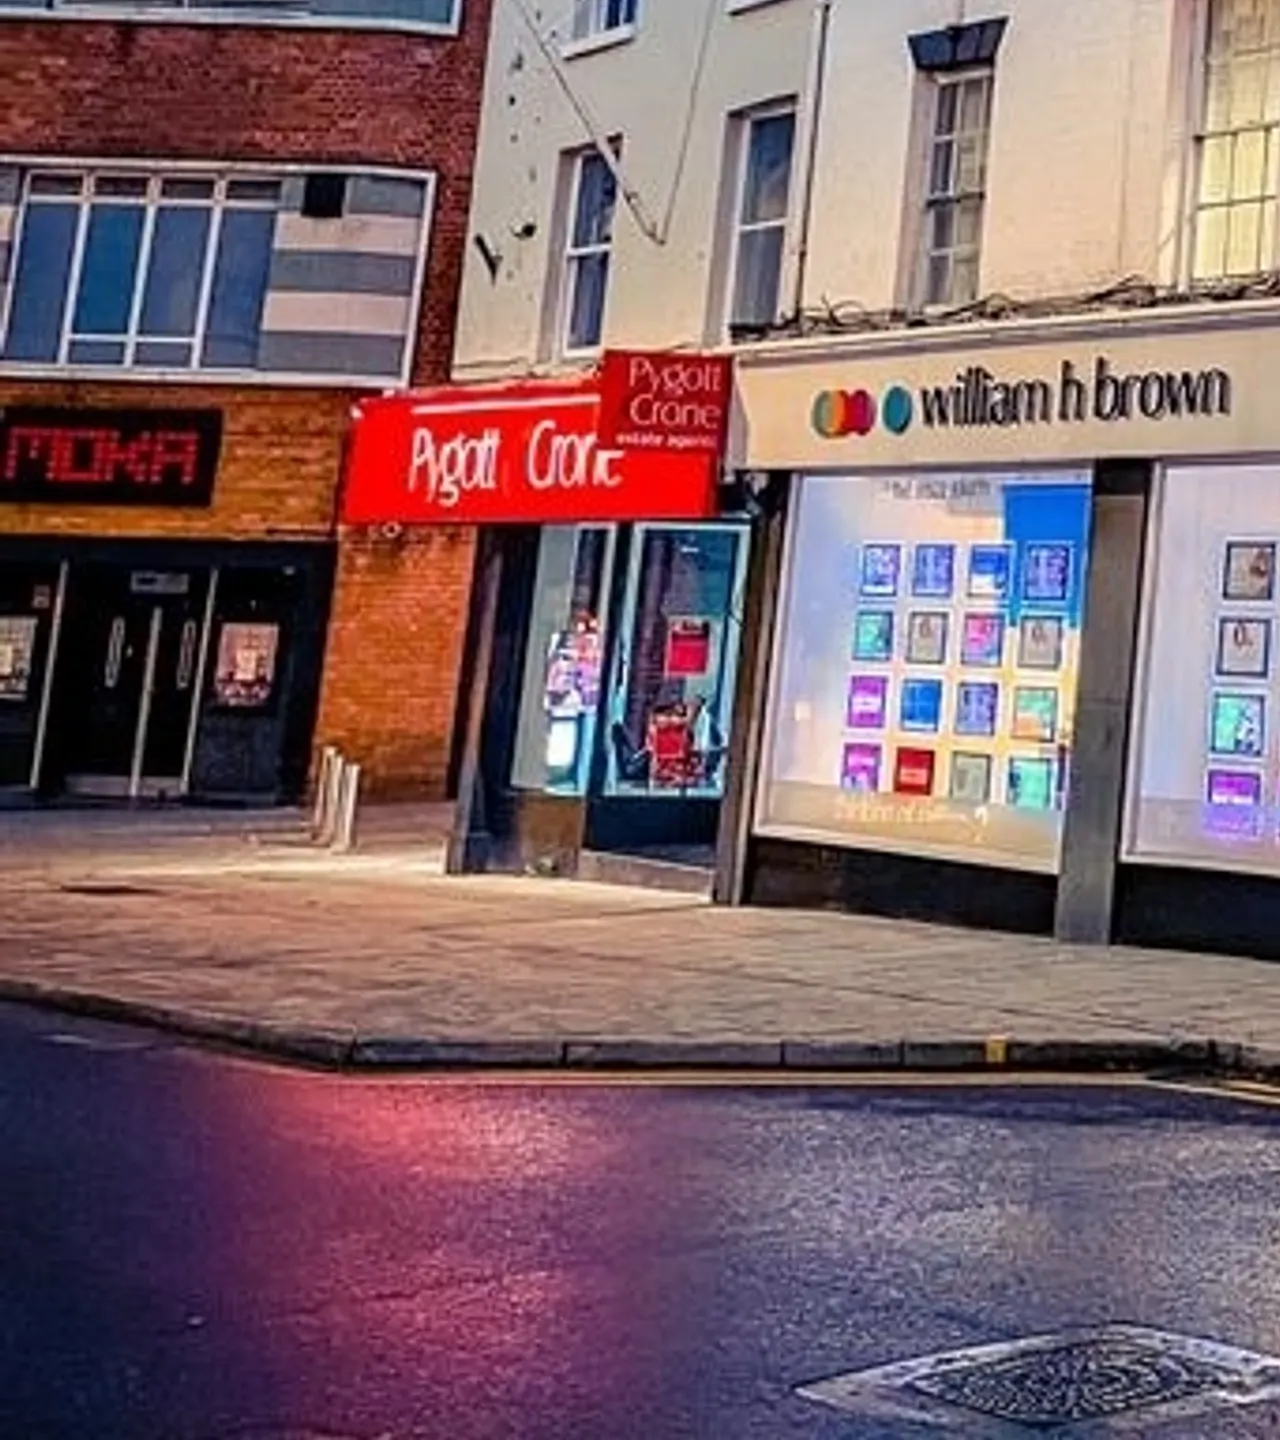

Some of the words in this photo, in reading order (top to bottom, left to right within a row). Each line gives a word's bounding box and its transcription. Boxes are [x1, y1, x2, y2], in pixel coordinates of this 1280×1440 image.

[629, 356, 722, 396] Pygott
[921, 365, 1051, 430] william
[1057, 359, 1085, 424] h
[1094, 355, 1231, 421] brown
[630, 393, 722, 429] Crane
[5, 425, 199, 485] MOKA
[406, 426, 502, 507] Pygott
